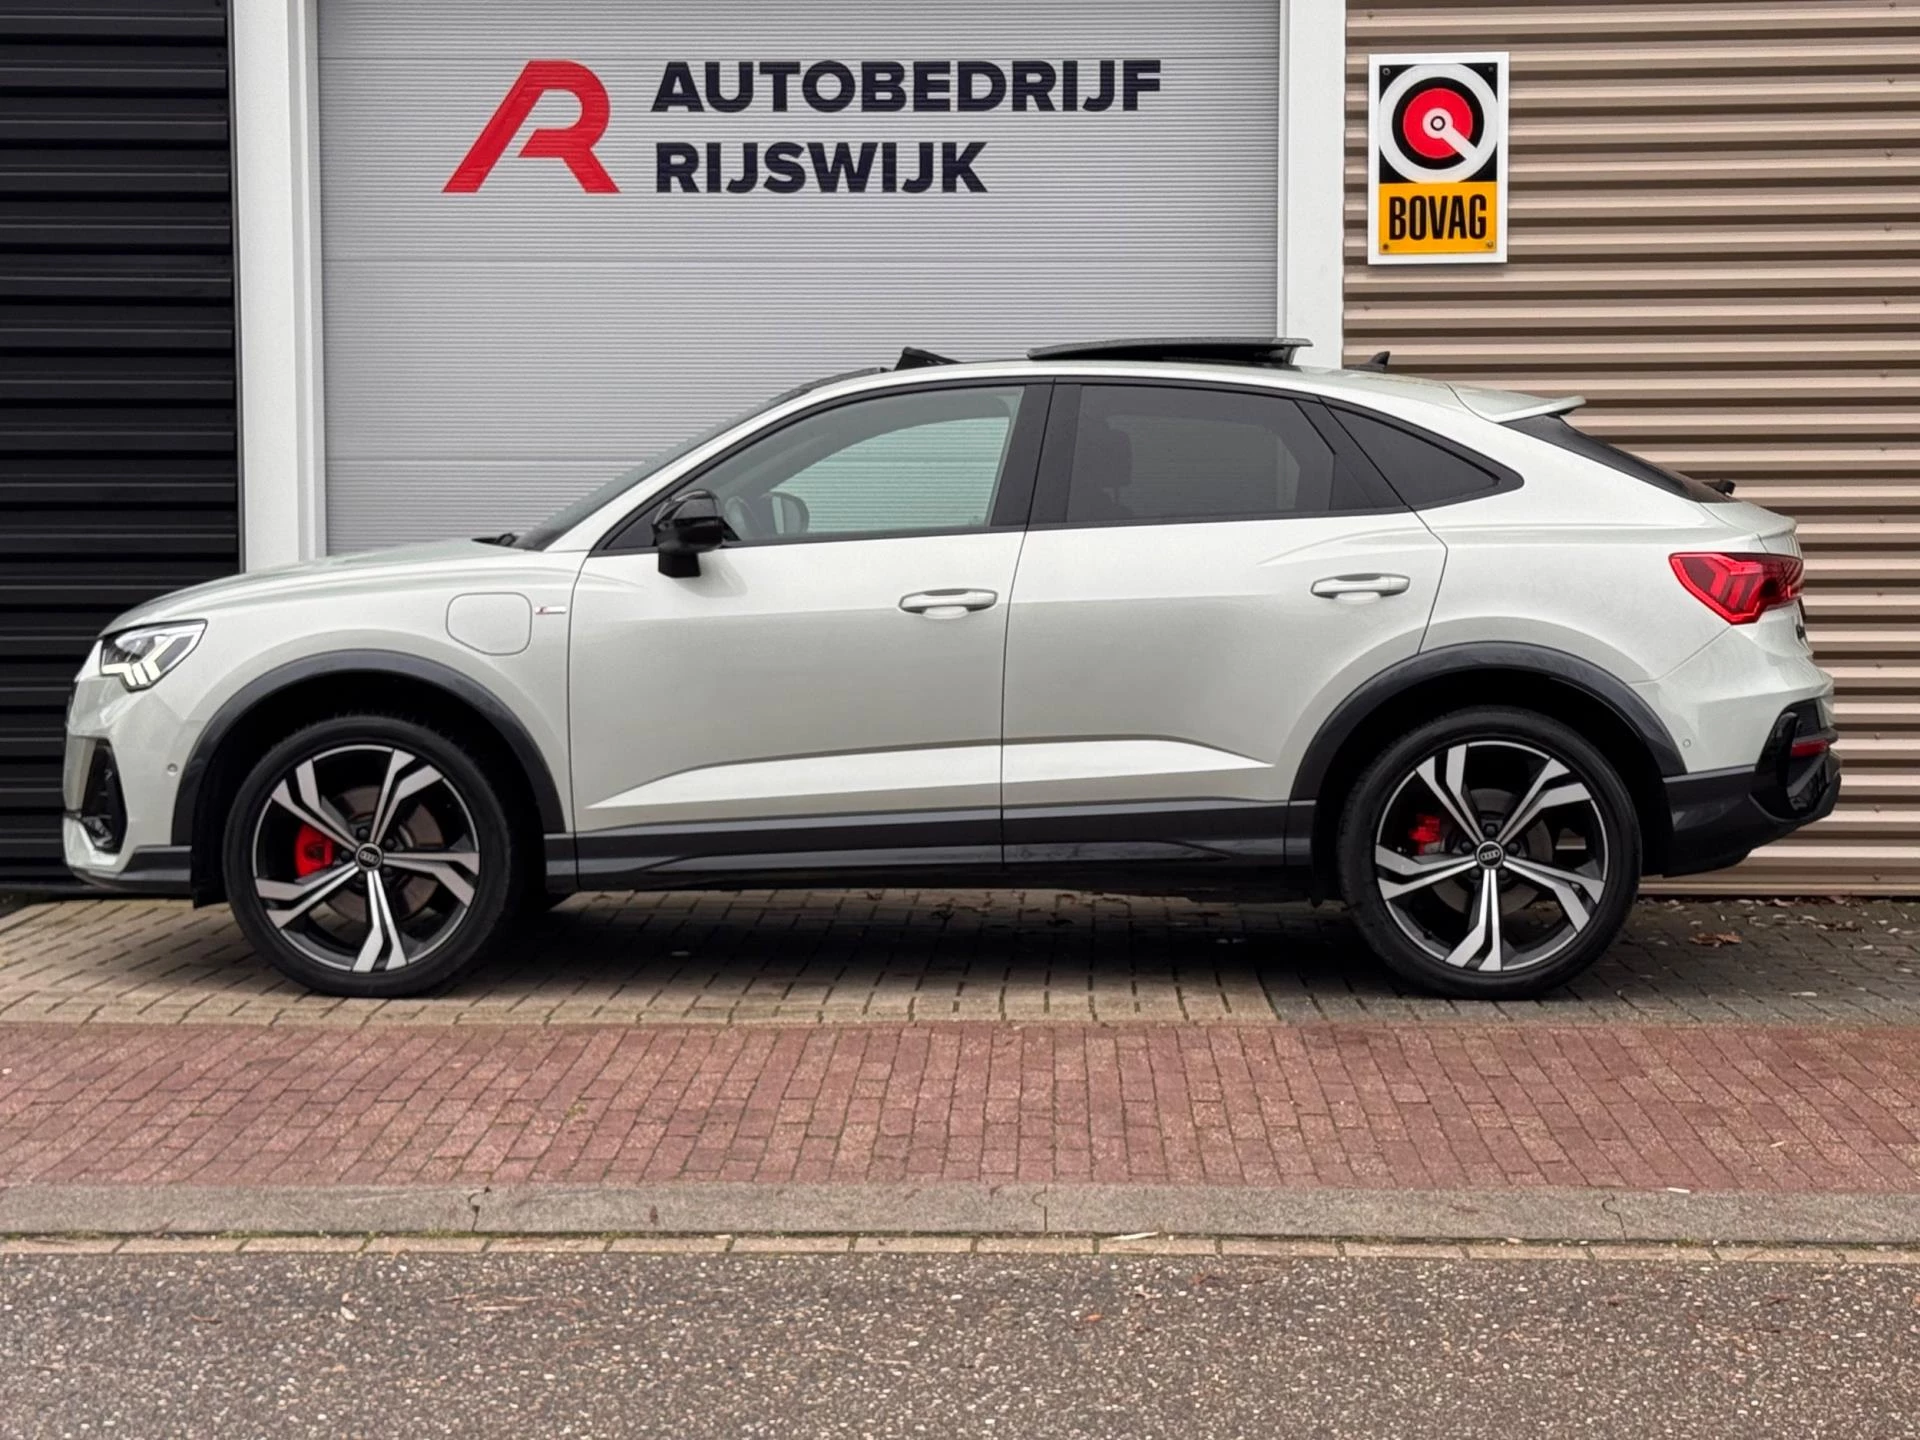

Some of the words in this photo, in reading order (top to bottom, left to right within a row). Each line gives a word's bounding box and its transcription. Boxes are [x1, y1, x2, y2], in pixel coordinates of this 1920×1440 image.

[651, 60, 1161, 112] AUTOBEDRIJF
[656, 142, 988, 194] RIJSWIJK
[1389, 194, 1486, 240] BOVAG
